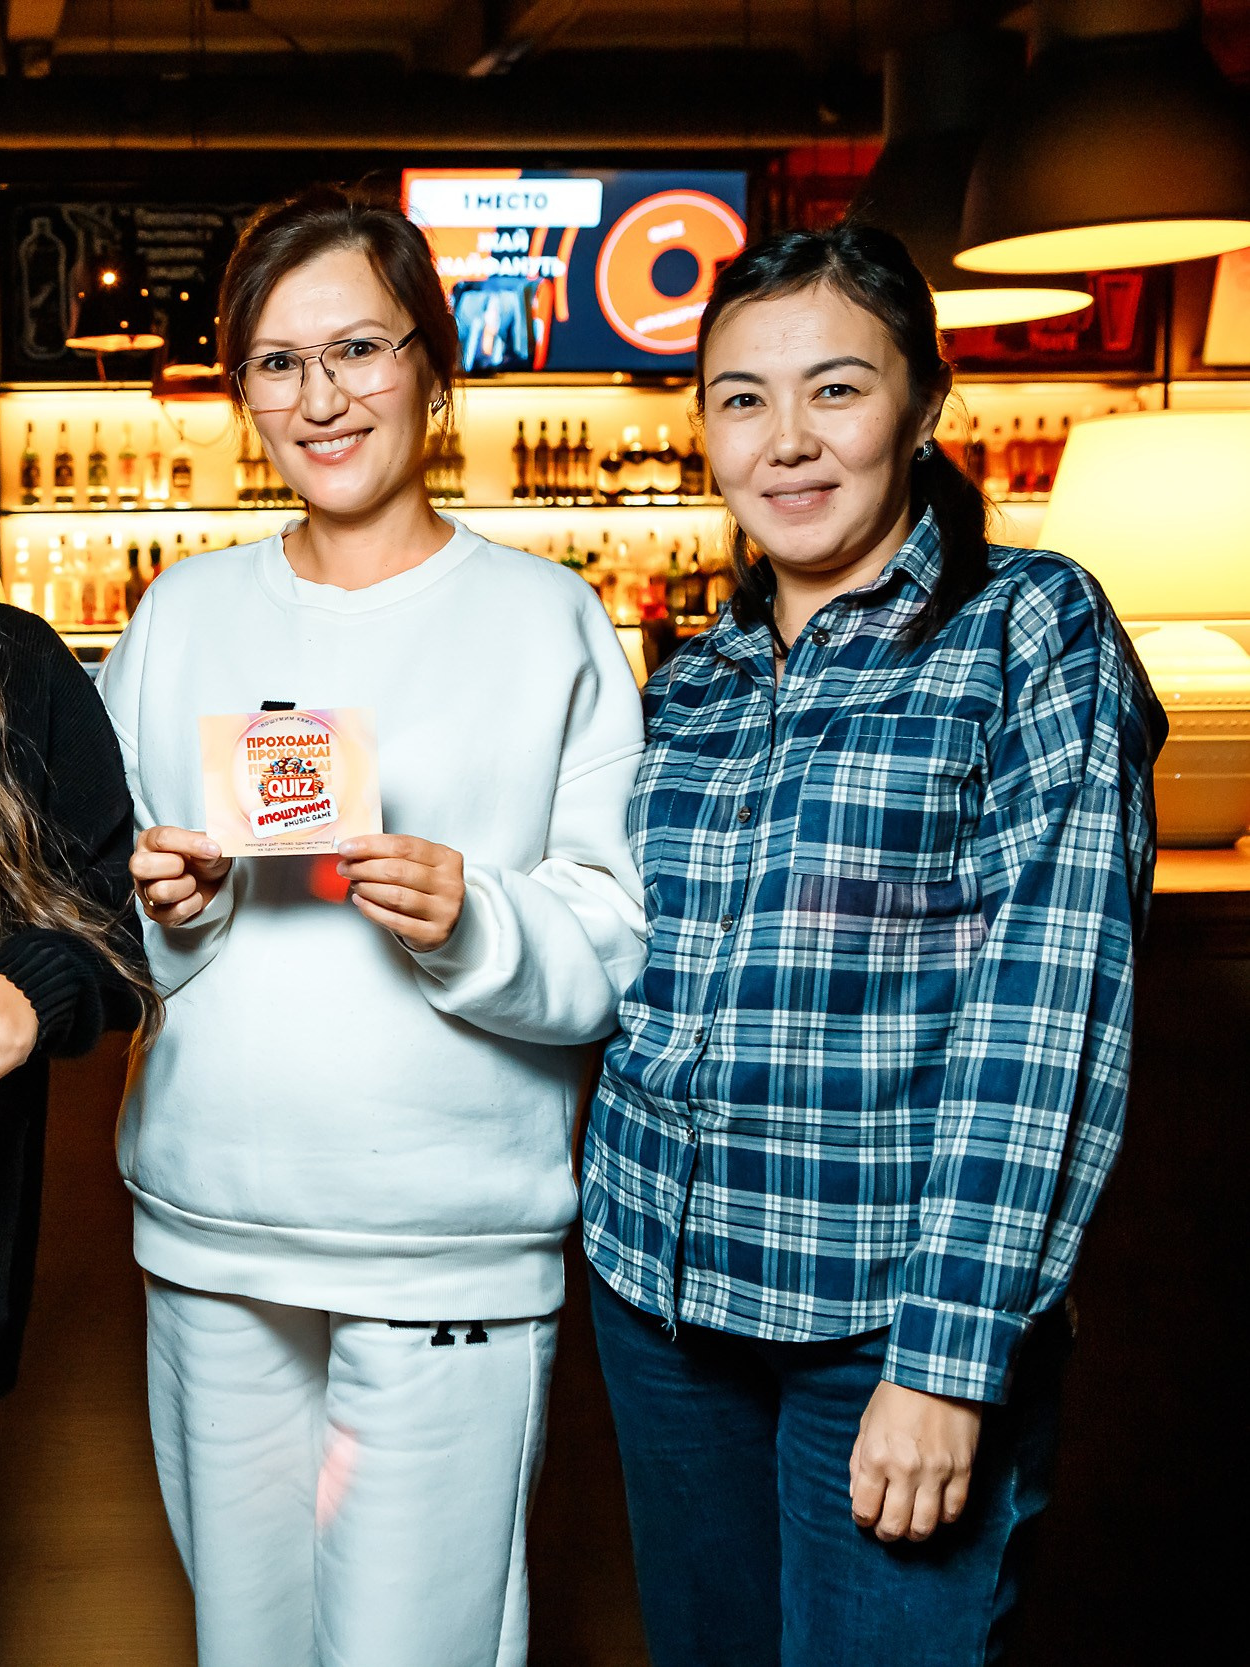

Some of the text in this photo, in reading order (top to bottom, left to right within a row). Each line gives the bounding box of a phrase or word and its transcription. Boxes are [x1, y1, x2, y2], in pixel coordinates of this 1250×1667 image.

[246, 733, 329, 748] ПРОХОДКА!
[267, 778, 314, 798] QUIZ
[257, 798, 331, 826] #ПОШУМИМ?
[284, 810, 331, 828] #MUSIC GAME
